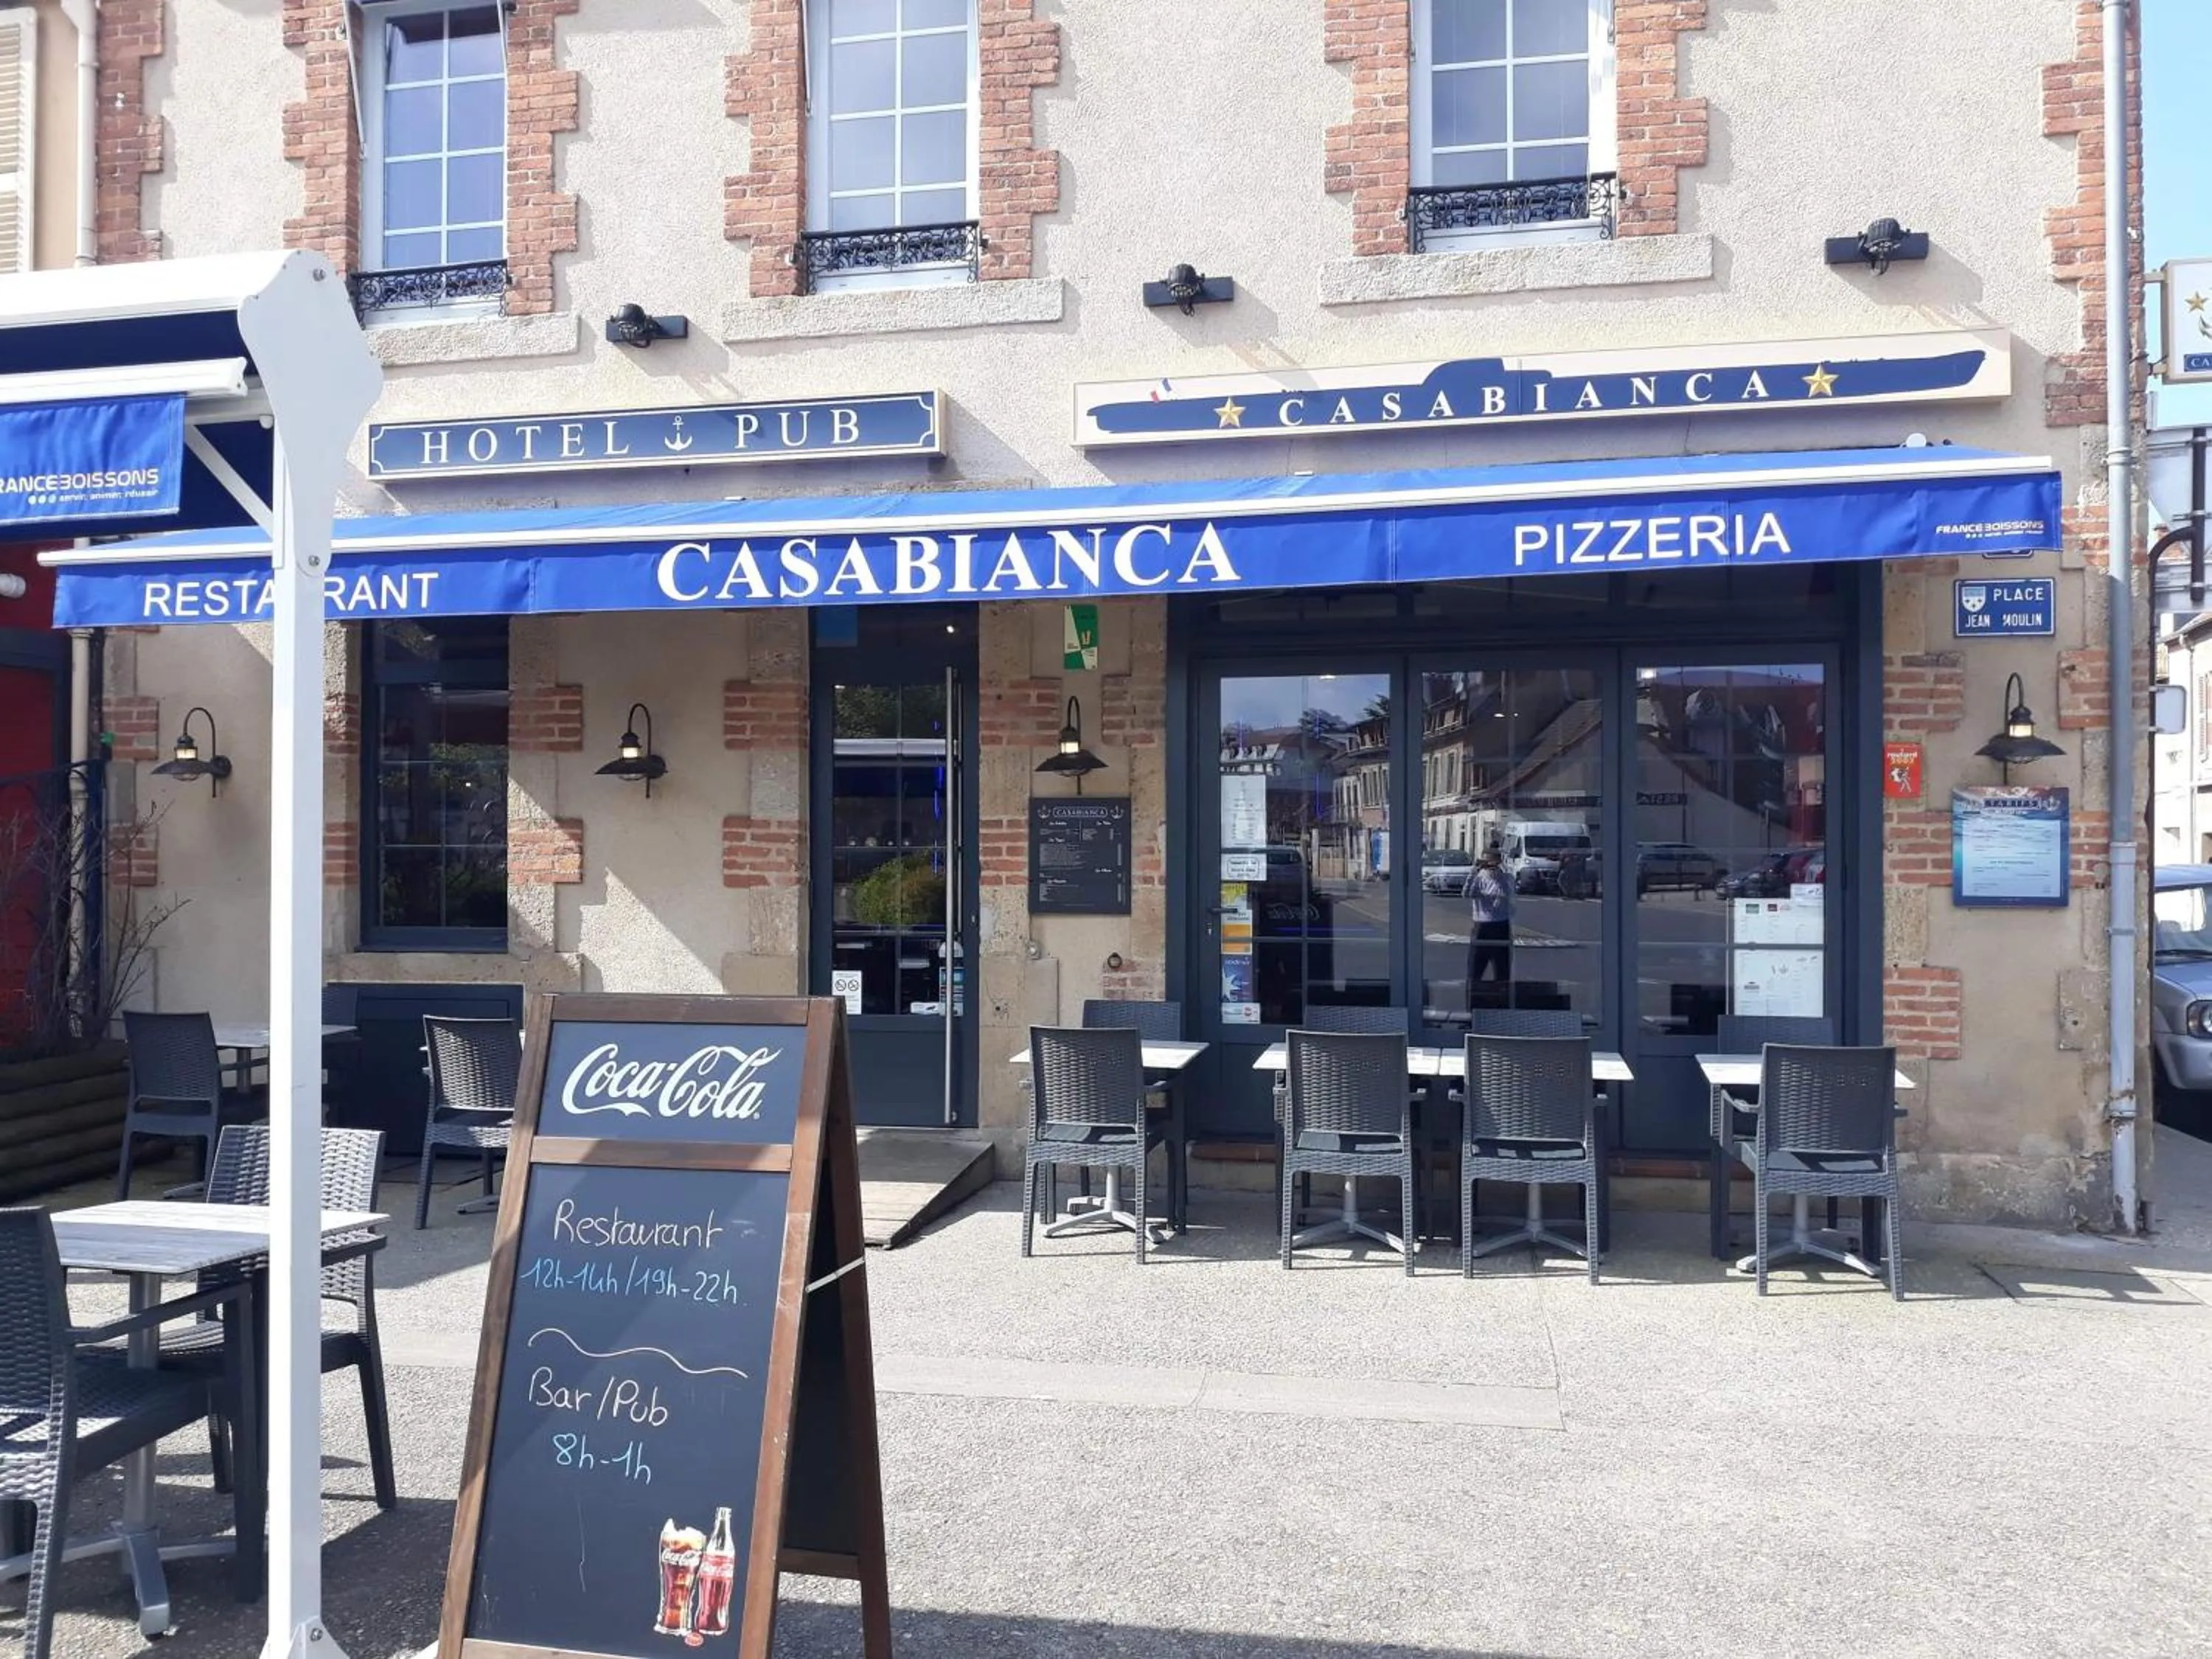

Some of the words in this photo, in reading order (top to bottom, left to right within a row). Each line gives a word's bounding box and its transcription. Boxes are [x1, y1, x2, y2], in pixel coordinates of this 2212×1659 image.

[1279, 369, 1770, 427] CASABIANCA
[421, 421, 629, 464] HOTEL
[734, 408, 860, 448] PUB
[657, 521, 1241, 601] CASABIANCA
[1514, 512, 1792, 566] PIZZERIA
[143, 572, 439, 617] RESTARANT
[1965, 614, 1991, 627] JEAN
[2003, 613, 2042, 627] MOULIN
[1993, 587, 2045, 602] PLACE
[562, 1043, 784, 1119] Coca-Cola
[554, 1198, 724, 1249] Restaurant
[553, 1433, 652, 1485] 8h-1h
